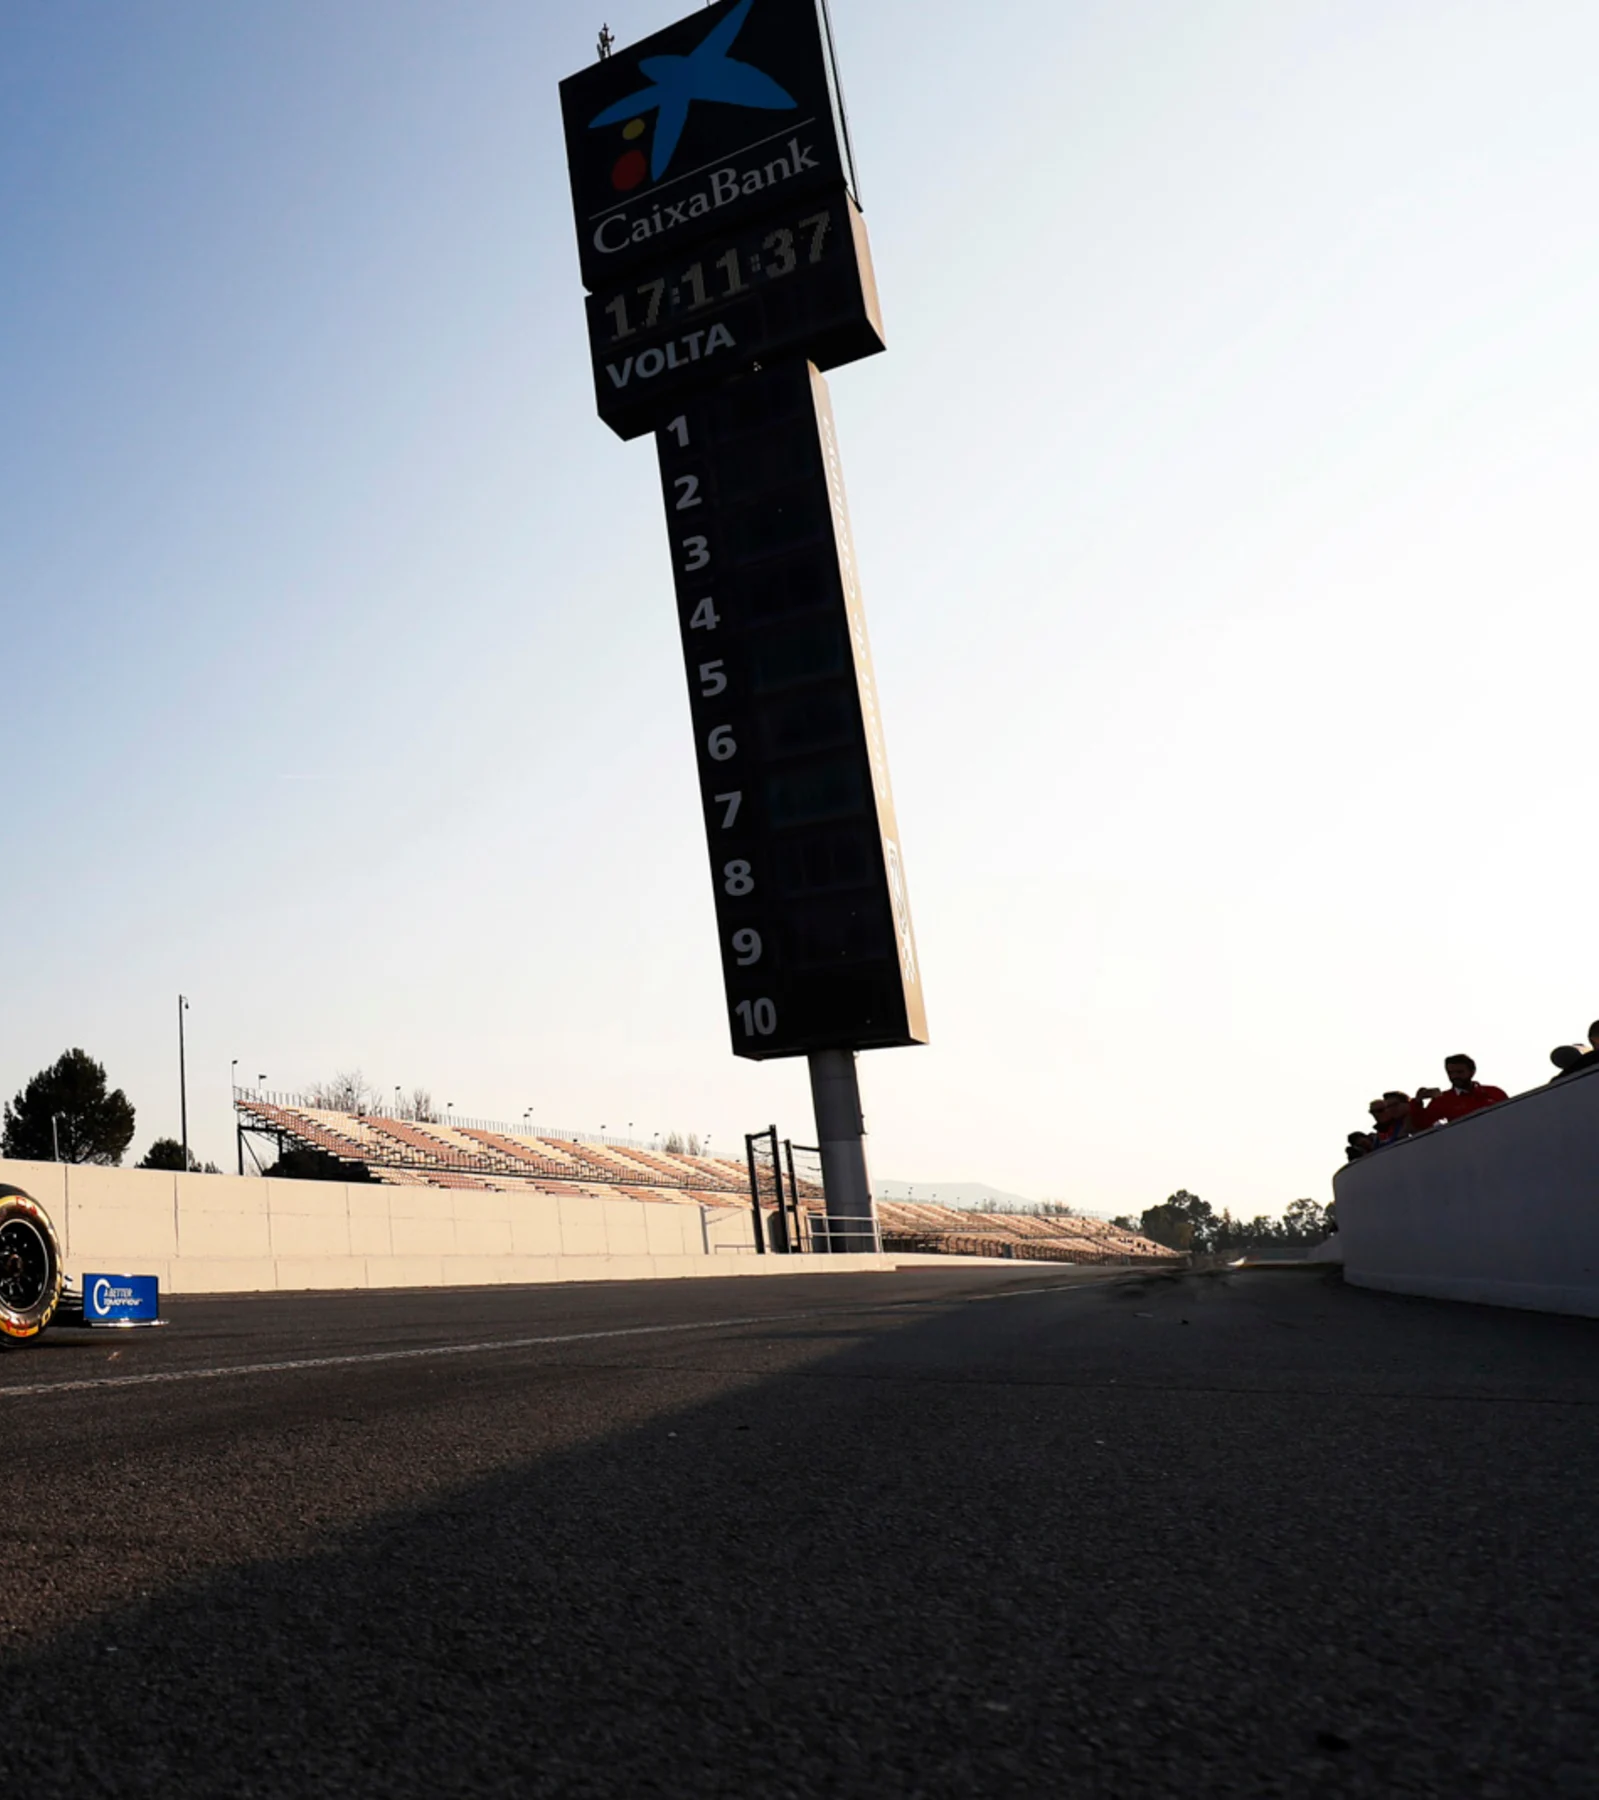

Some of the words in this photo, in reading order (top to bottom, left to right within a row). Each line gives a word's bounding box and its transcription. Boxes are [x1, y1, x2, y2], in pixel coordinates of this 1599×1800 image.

[593, 137, 820, 254] CaixaBank
[605, 211, 832, 342] 17:11:37
[605, 322, 736, 389] VOLTA
[666, 414, 690, 448] 1
[674, 474, 702, 511] 2
[682, 535, 710, 572] 3
[689, 596, 721, 631] 4
[699, 659, 728, 697] 5
[707, 724, 737, 761] 6
[714, 790, 742, 829] 7
[723, 859, 755, 897] 8
[731, 927, 763, 966] 9
[735, 997, 777, 1037] 10
